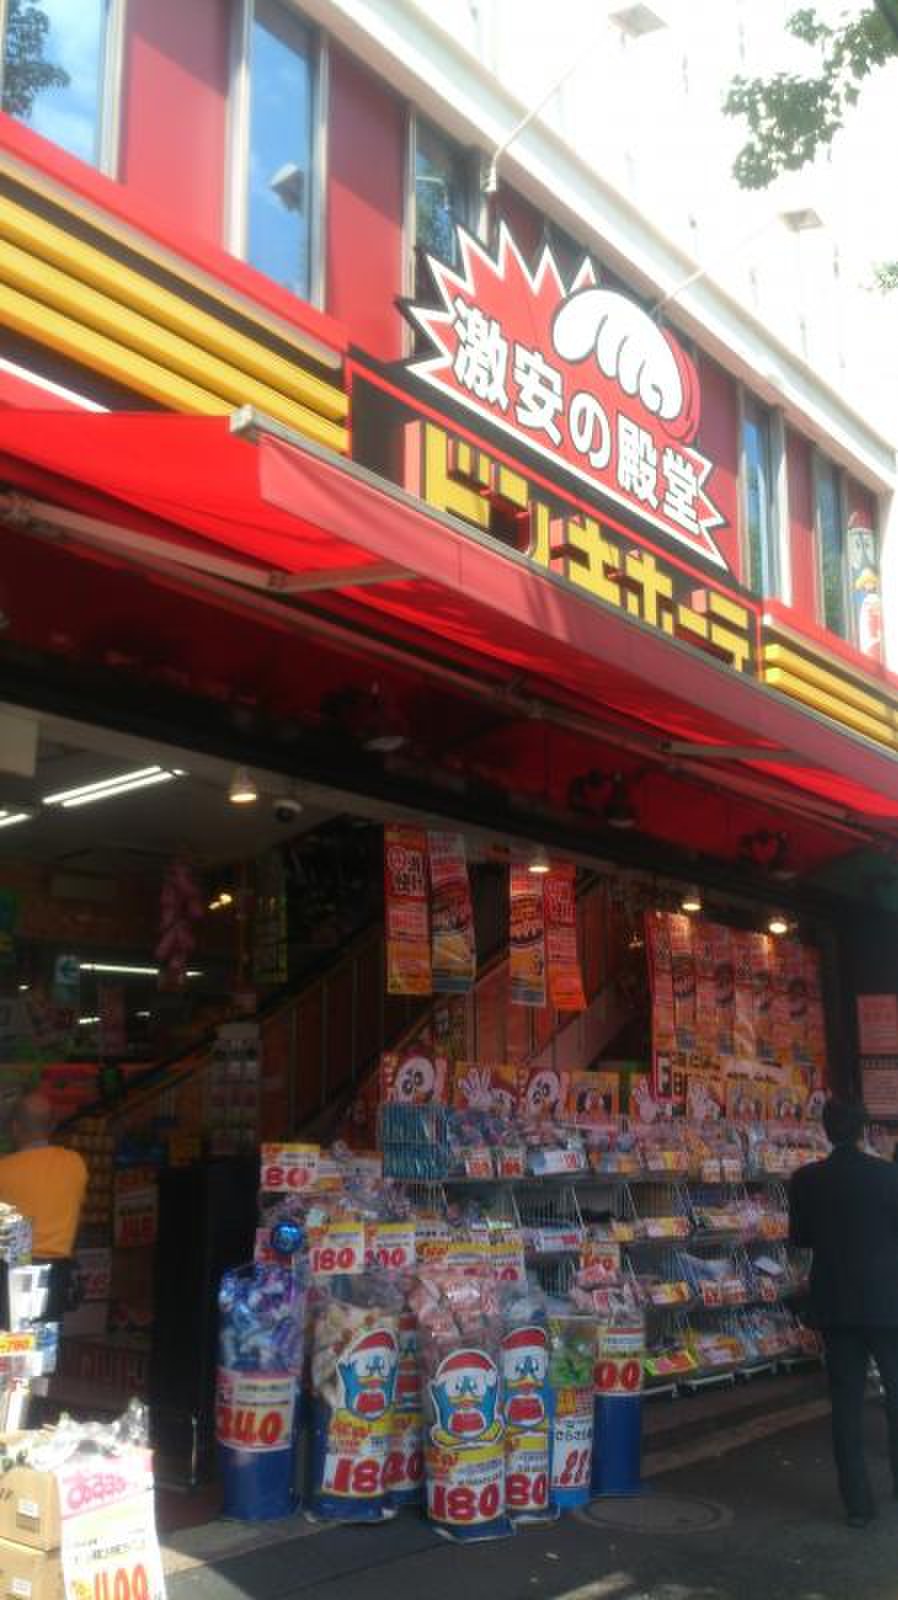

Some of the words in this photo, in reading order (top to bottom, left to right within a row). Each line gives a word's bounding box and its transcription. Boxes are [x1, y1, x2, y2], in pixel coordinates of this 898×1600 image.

[453, 297, 702, 534] 激安の殿堂
[312, 1248, 356, 1271] 180
[334, 1456, 385, 1494] 18
[432, 1482, 499, 1521] 180
